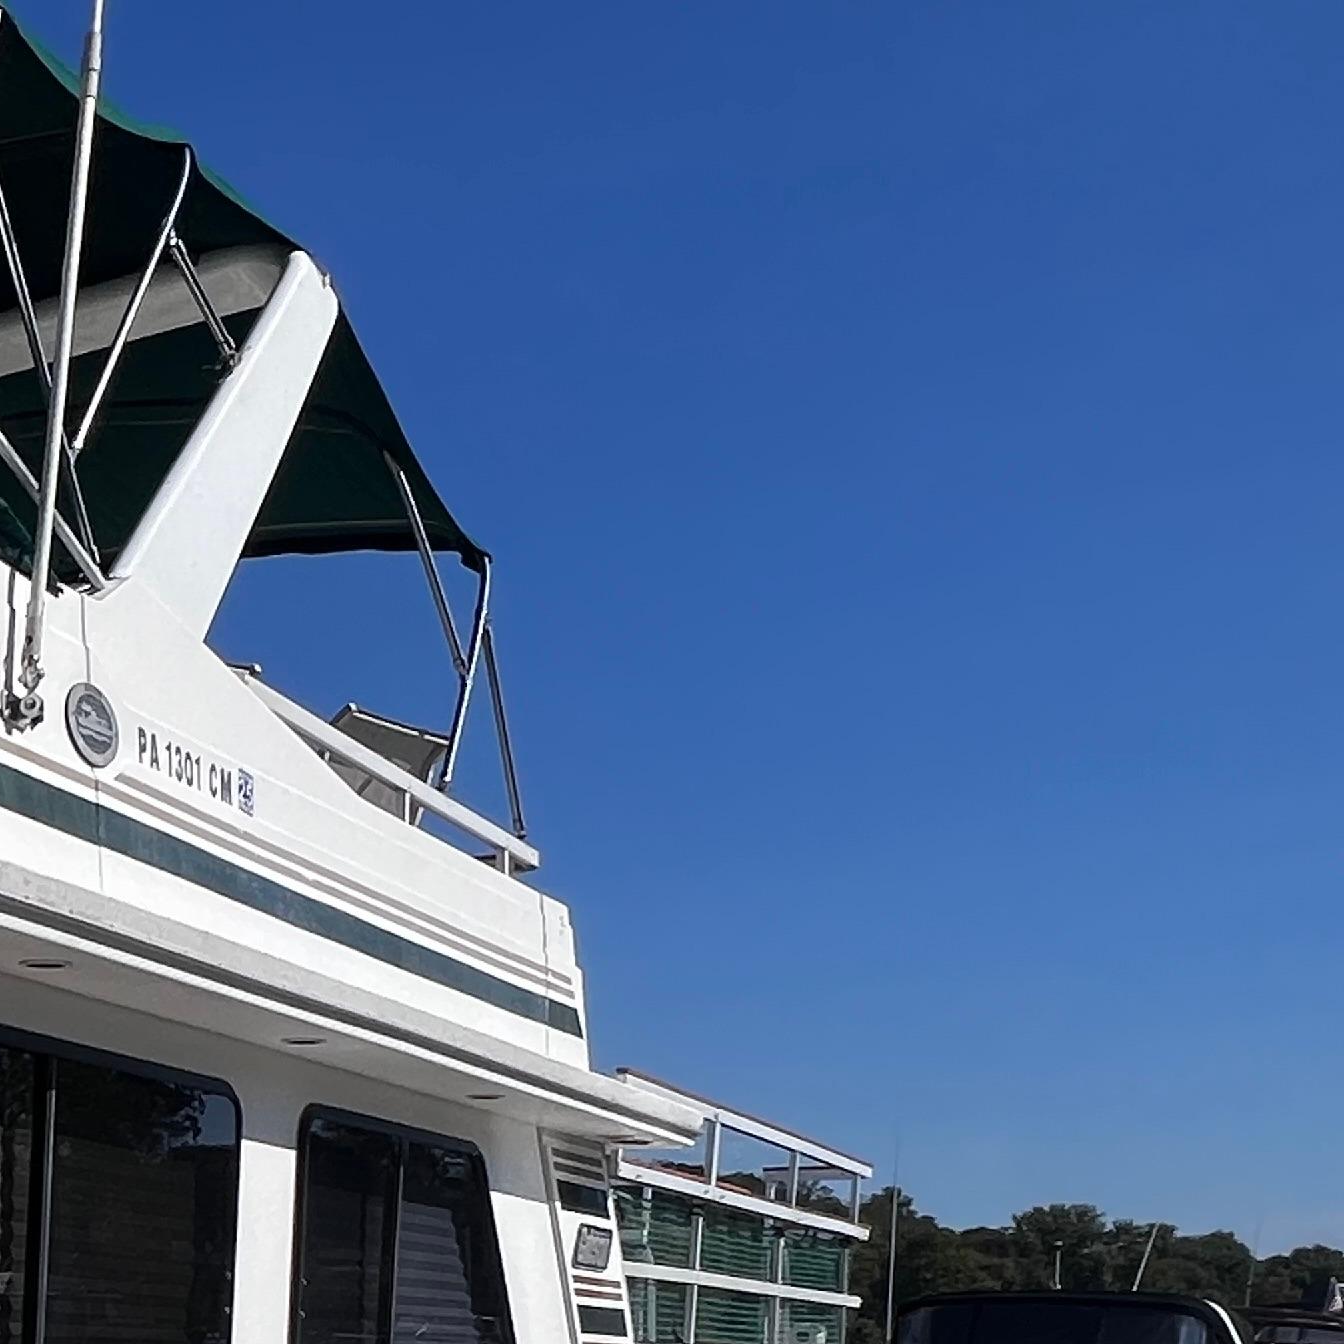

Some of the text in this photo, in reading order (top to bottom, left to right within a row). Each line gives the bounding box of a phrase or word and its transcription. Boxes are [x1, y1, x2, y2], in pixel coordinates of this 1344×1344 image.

[138, 726, 233, 806] PA 1301 CM
